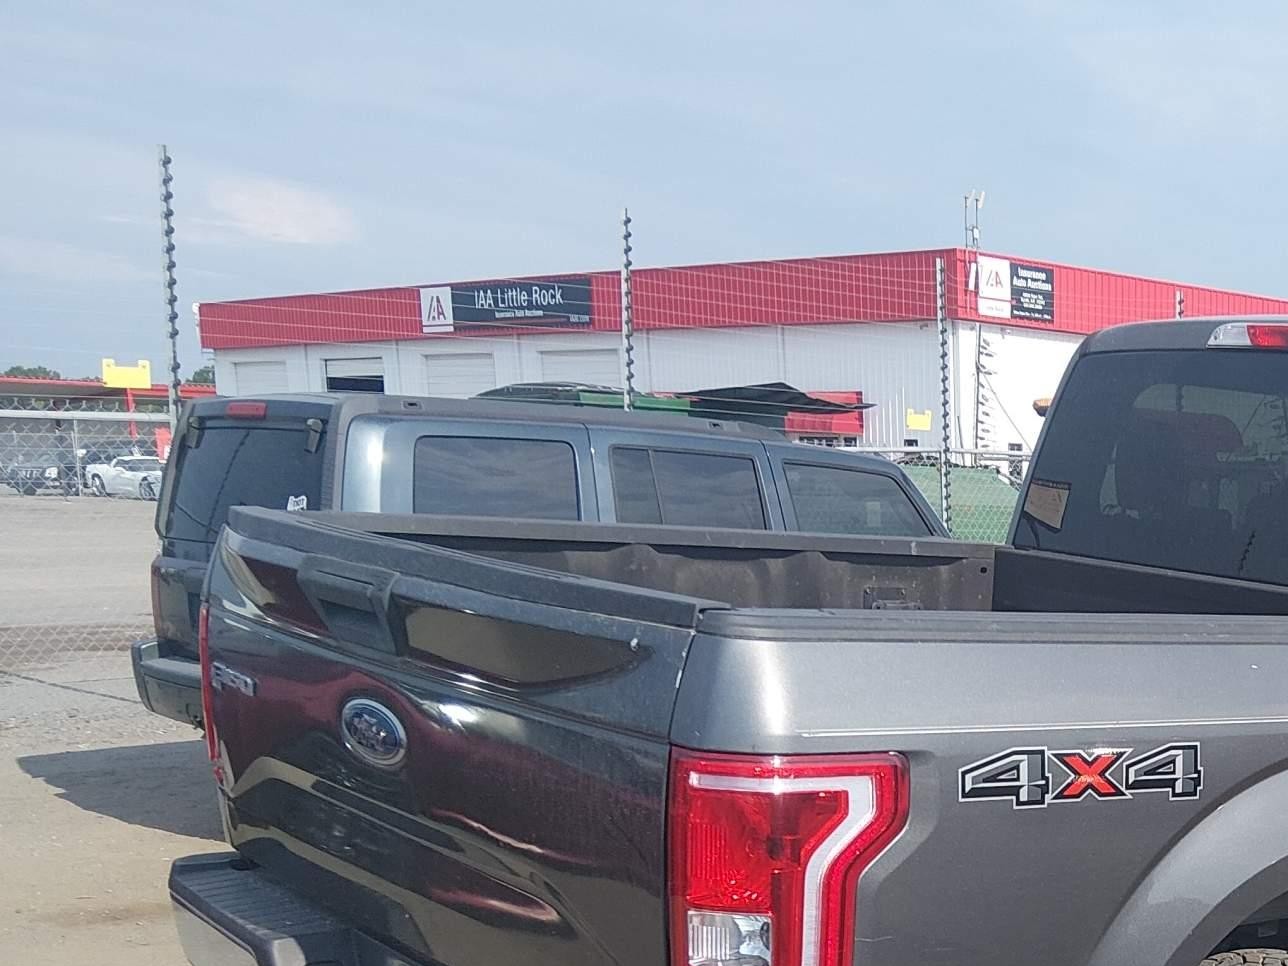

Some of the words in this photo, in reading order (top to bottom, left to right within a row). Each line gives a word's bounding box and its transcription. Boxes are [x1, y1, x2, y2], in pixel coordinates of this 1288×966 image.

[475, 289, 494, 309] IAA
[498, 287, 528, 308] Little
[532, 283, 563, 306] Rock
